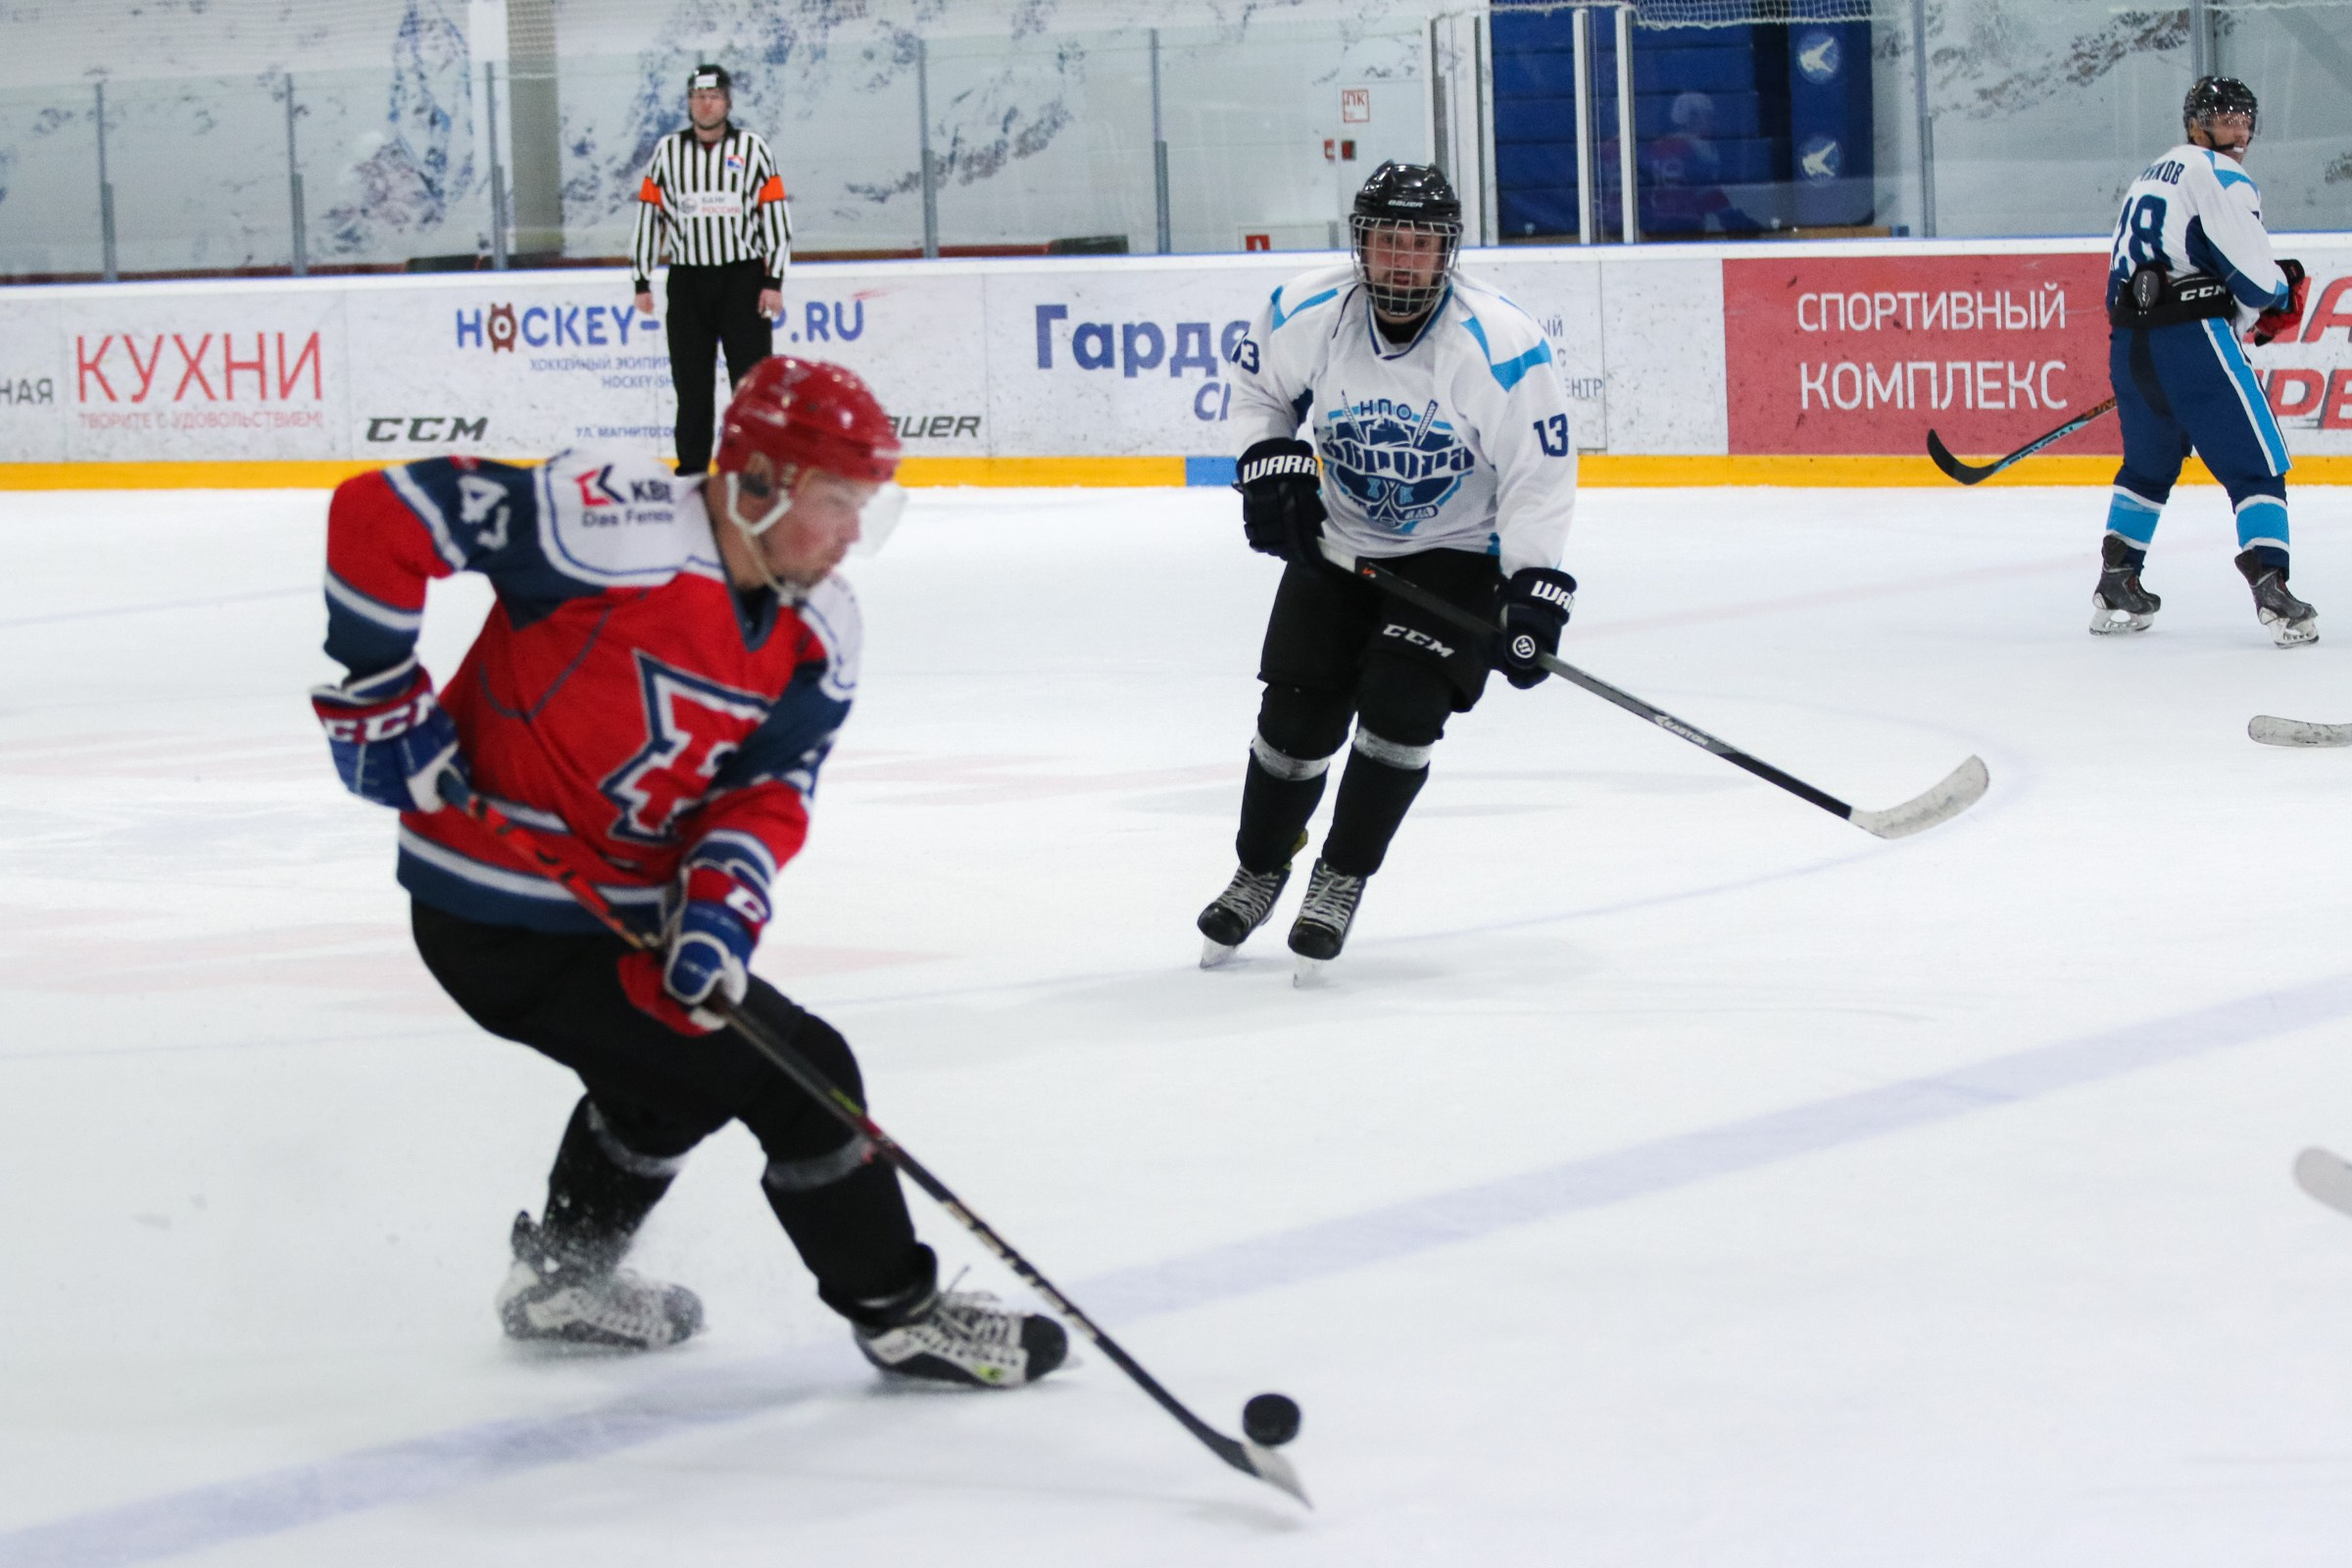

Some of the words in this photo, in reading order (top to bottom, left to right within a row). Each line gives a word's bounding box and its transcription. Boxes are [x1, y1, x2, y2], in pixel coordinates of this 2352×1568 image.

[1388, 199, 1424, 208] BAUER
[1796, 281, 2066, 331] СПОРТИВНЫЙ
[2180, 284, 2227, 302] CCM
[77, 332, 322, 403] КУХНИ
[1799, 361, 2068, 410] КОМПЛЕКС
[1360, 398, 1412, 421] НПО
[366, 416, 488, 442] CCM
[1534, 413, 1570, 458] 13
[1382, 622, 1454, 659] CCM
